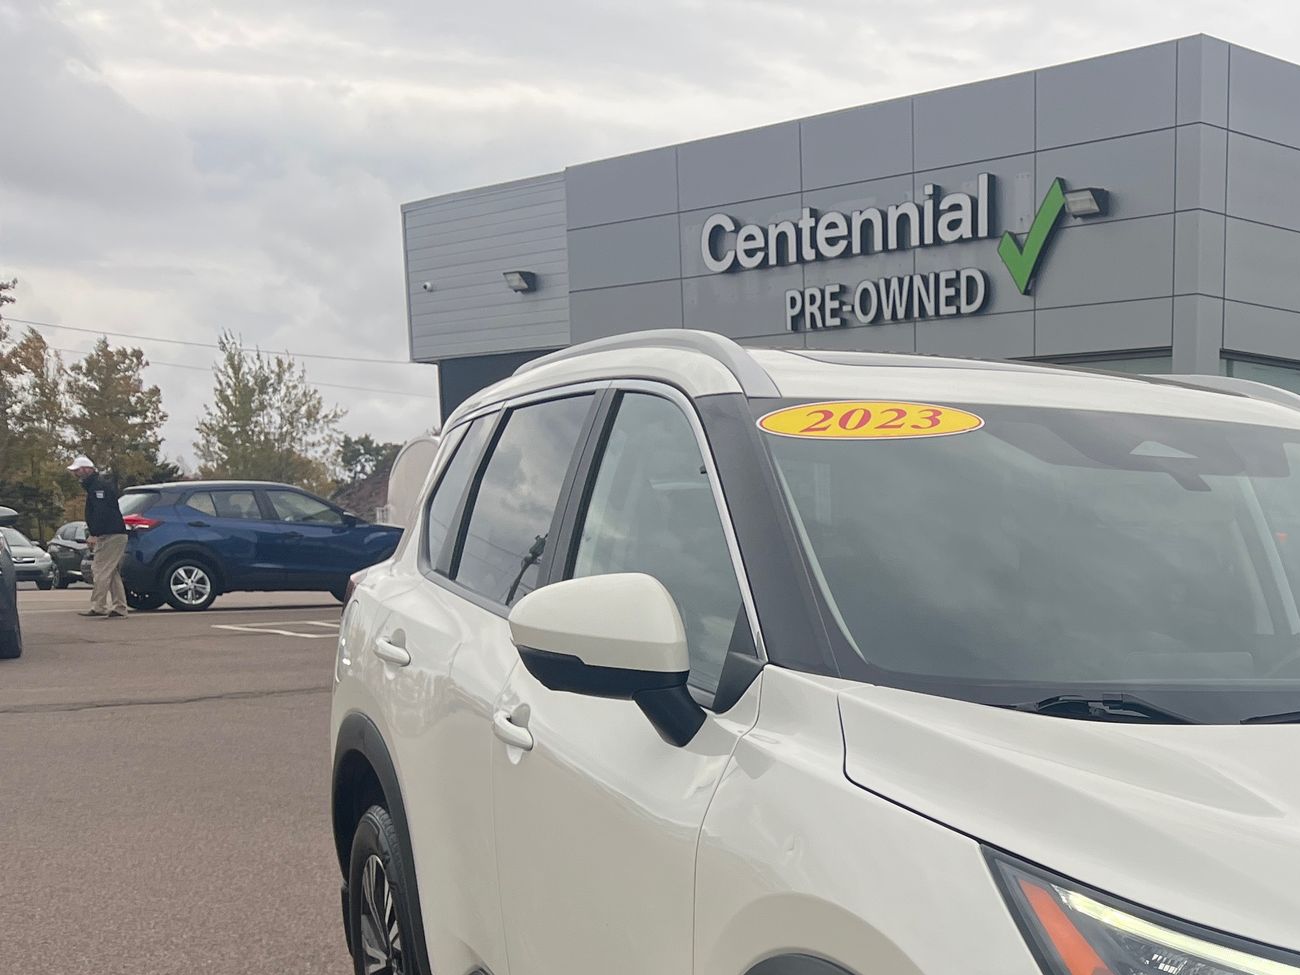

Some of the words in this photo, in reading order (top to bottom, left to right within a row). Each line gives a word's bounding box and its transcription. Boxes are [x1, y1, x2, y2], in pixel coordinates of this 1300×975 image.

[701, 172, 996, 273] Centennial
[785, 267, 989, 331] PRE-OWNED
[800, 407, 943, 434] 2023
